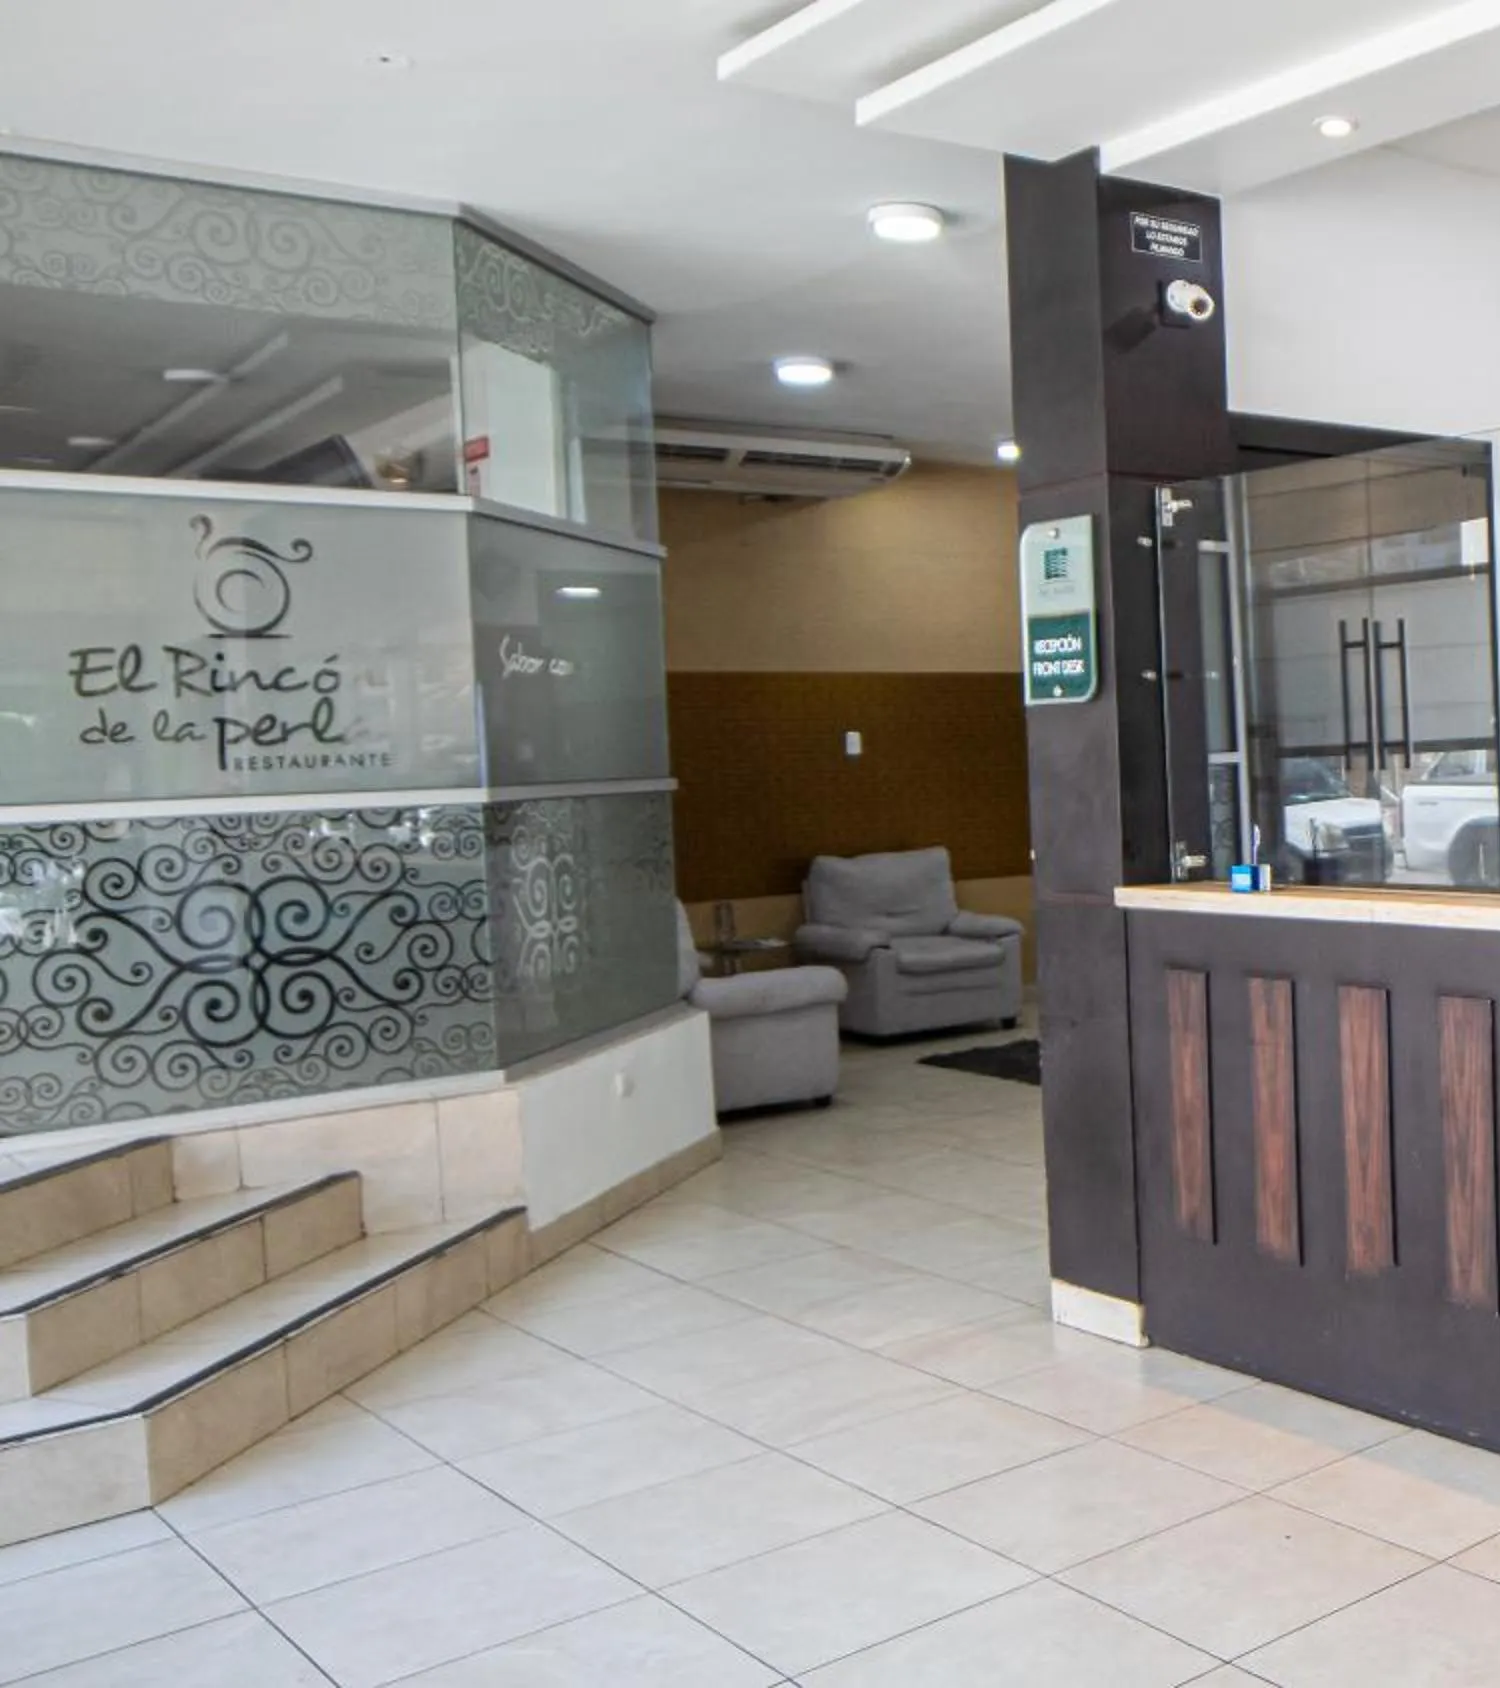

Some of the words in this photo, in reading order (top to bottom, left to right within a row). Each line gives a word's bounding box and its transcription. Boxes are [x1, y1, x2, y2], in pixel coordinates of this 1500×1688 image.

[69, 643, 157, 698] El
[162, 645, 388, 699] Rincó
[1033, 660, 1060, 677] FRONT
[1061, 659, 1085, 675] DESK
[80, 707, 135, 744] de
[153, 708, 207, 743] la
[212, 696, 388, 772] perl
[233, 752, 394, 772] RESTAURANTE
